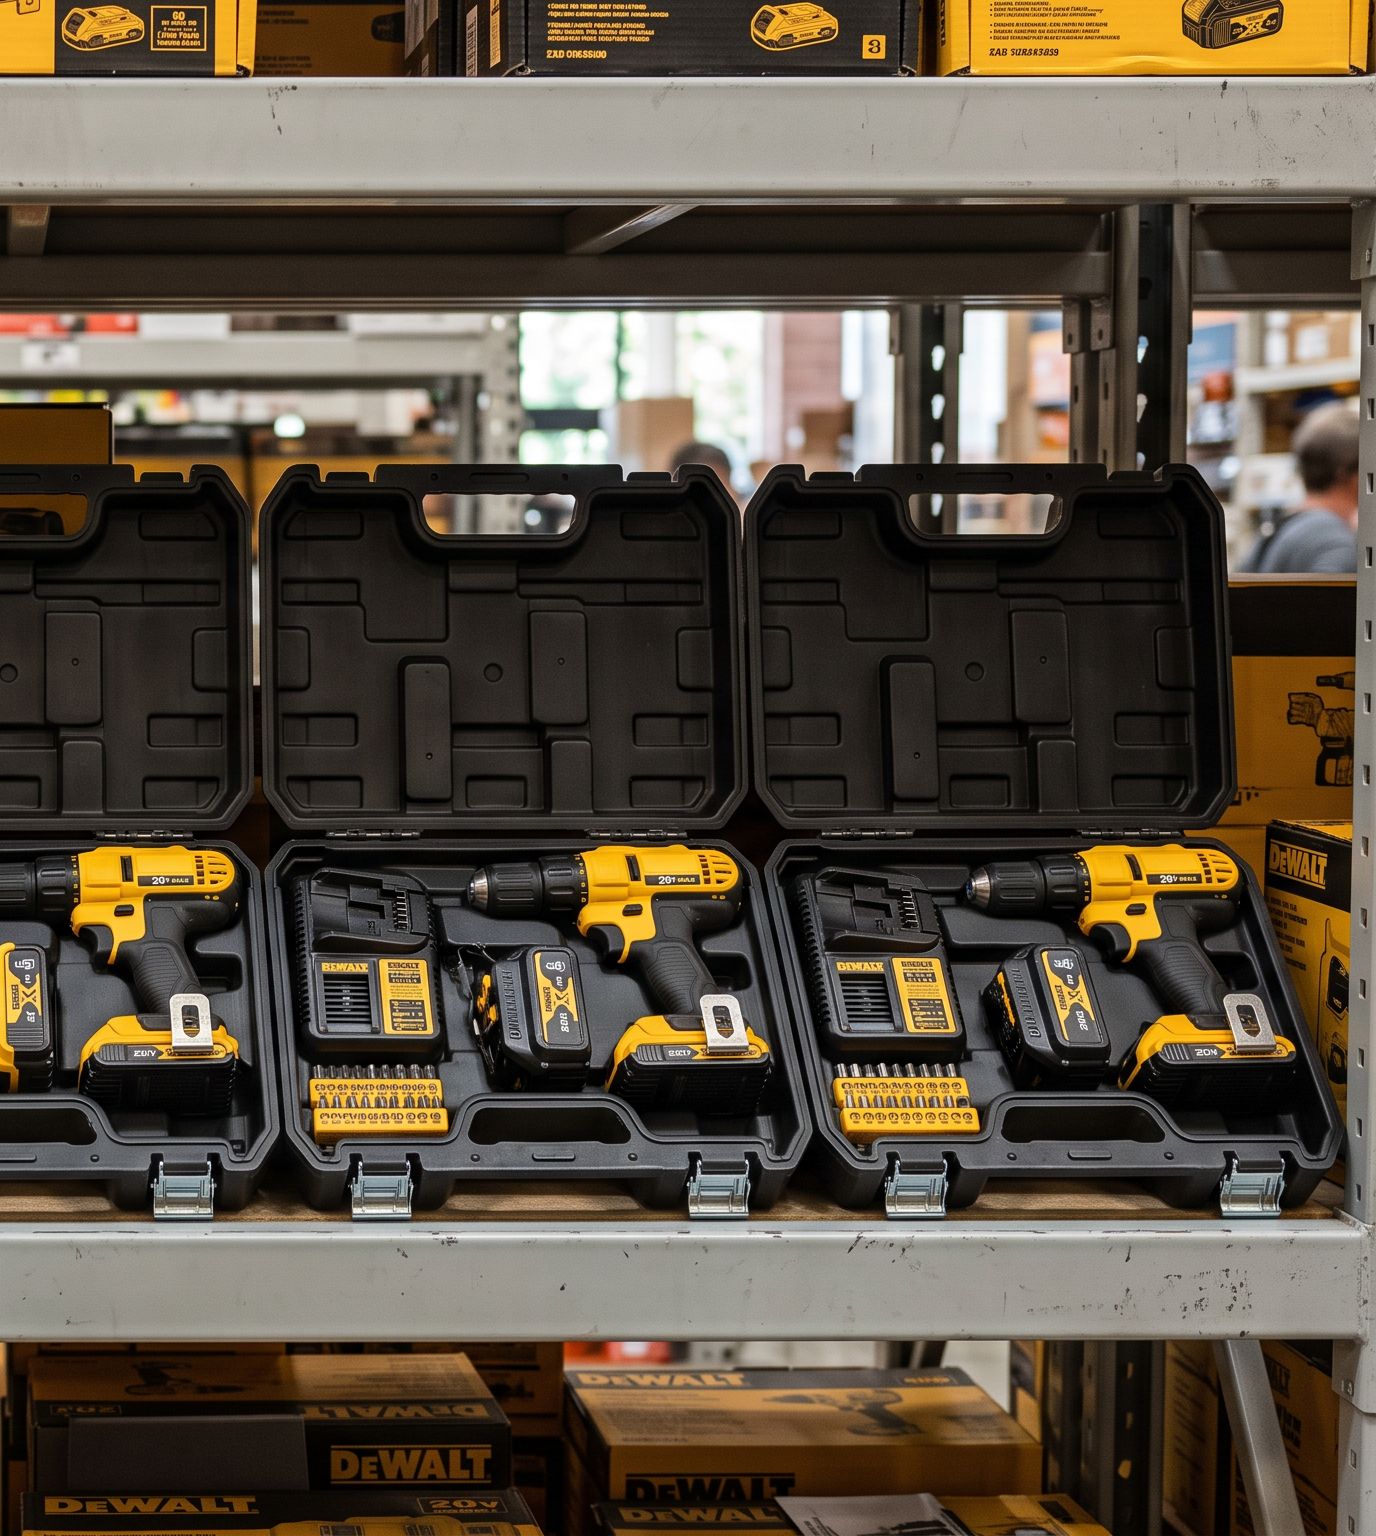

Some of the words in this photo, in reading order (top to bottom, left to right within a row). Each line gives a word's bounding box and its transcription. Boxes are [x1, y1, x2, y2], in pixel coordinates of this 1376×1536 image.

[1269, 842, 1328, 886] DEWALT
[329, 1448, 492, 1481] DEWALT
[44, 1497, 260, 1514] DEWALT
